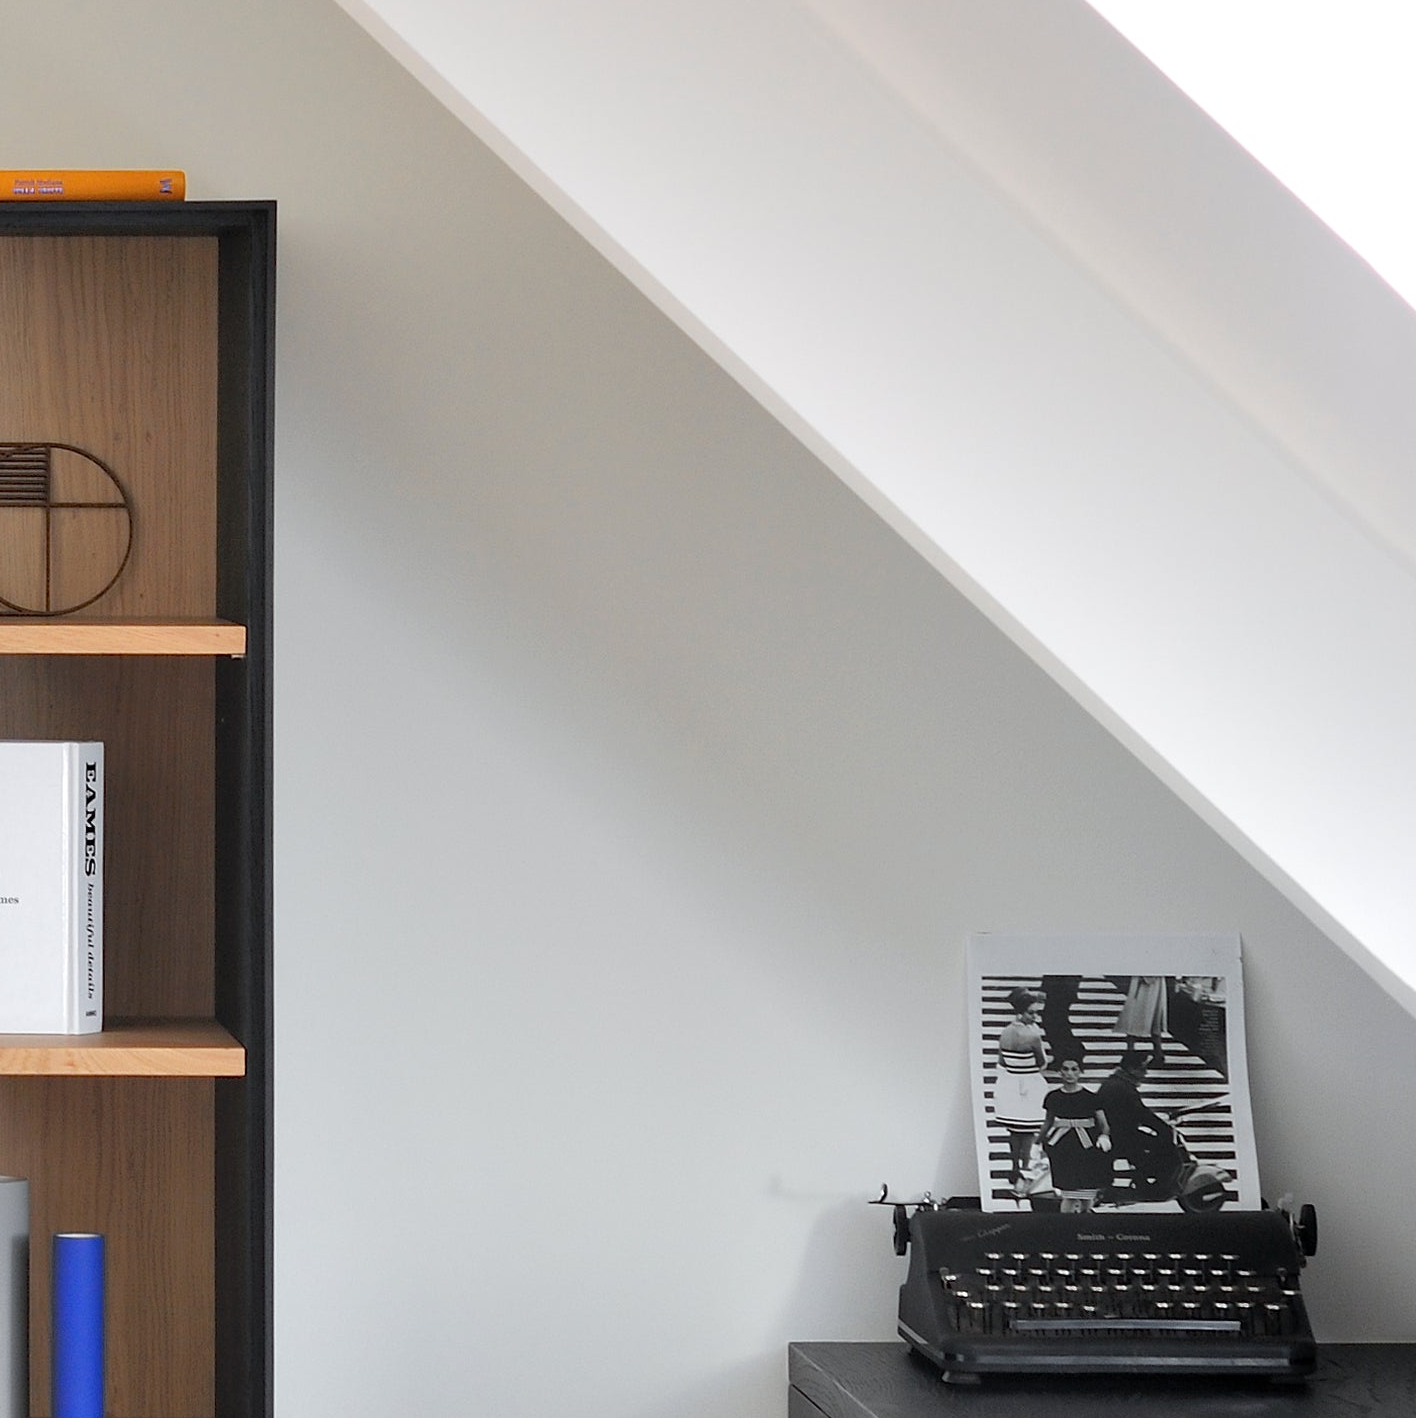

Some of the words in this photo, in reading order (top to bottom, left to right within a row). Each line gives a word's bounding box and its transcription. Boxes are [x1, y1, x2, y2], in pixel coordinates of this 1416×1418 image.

[84, 761, 97, 877] EAMES
[85, 882, 96, 949] beautiful
[86, 951, 96, 1000] details
